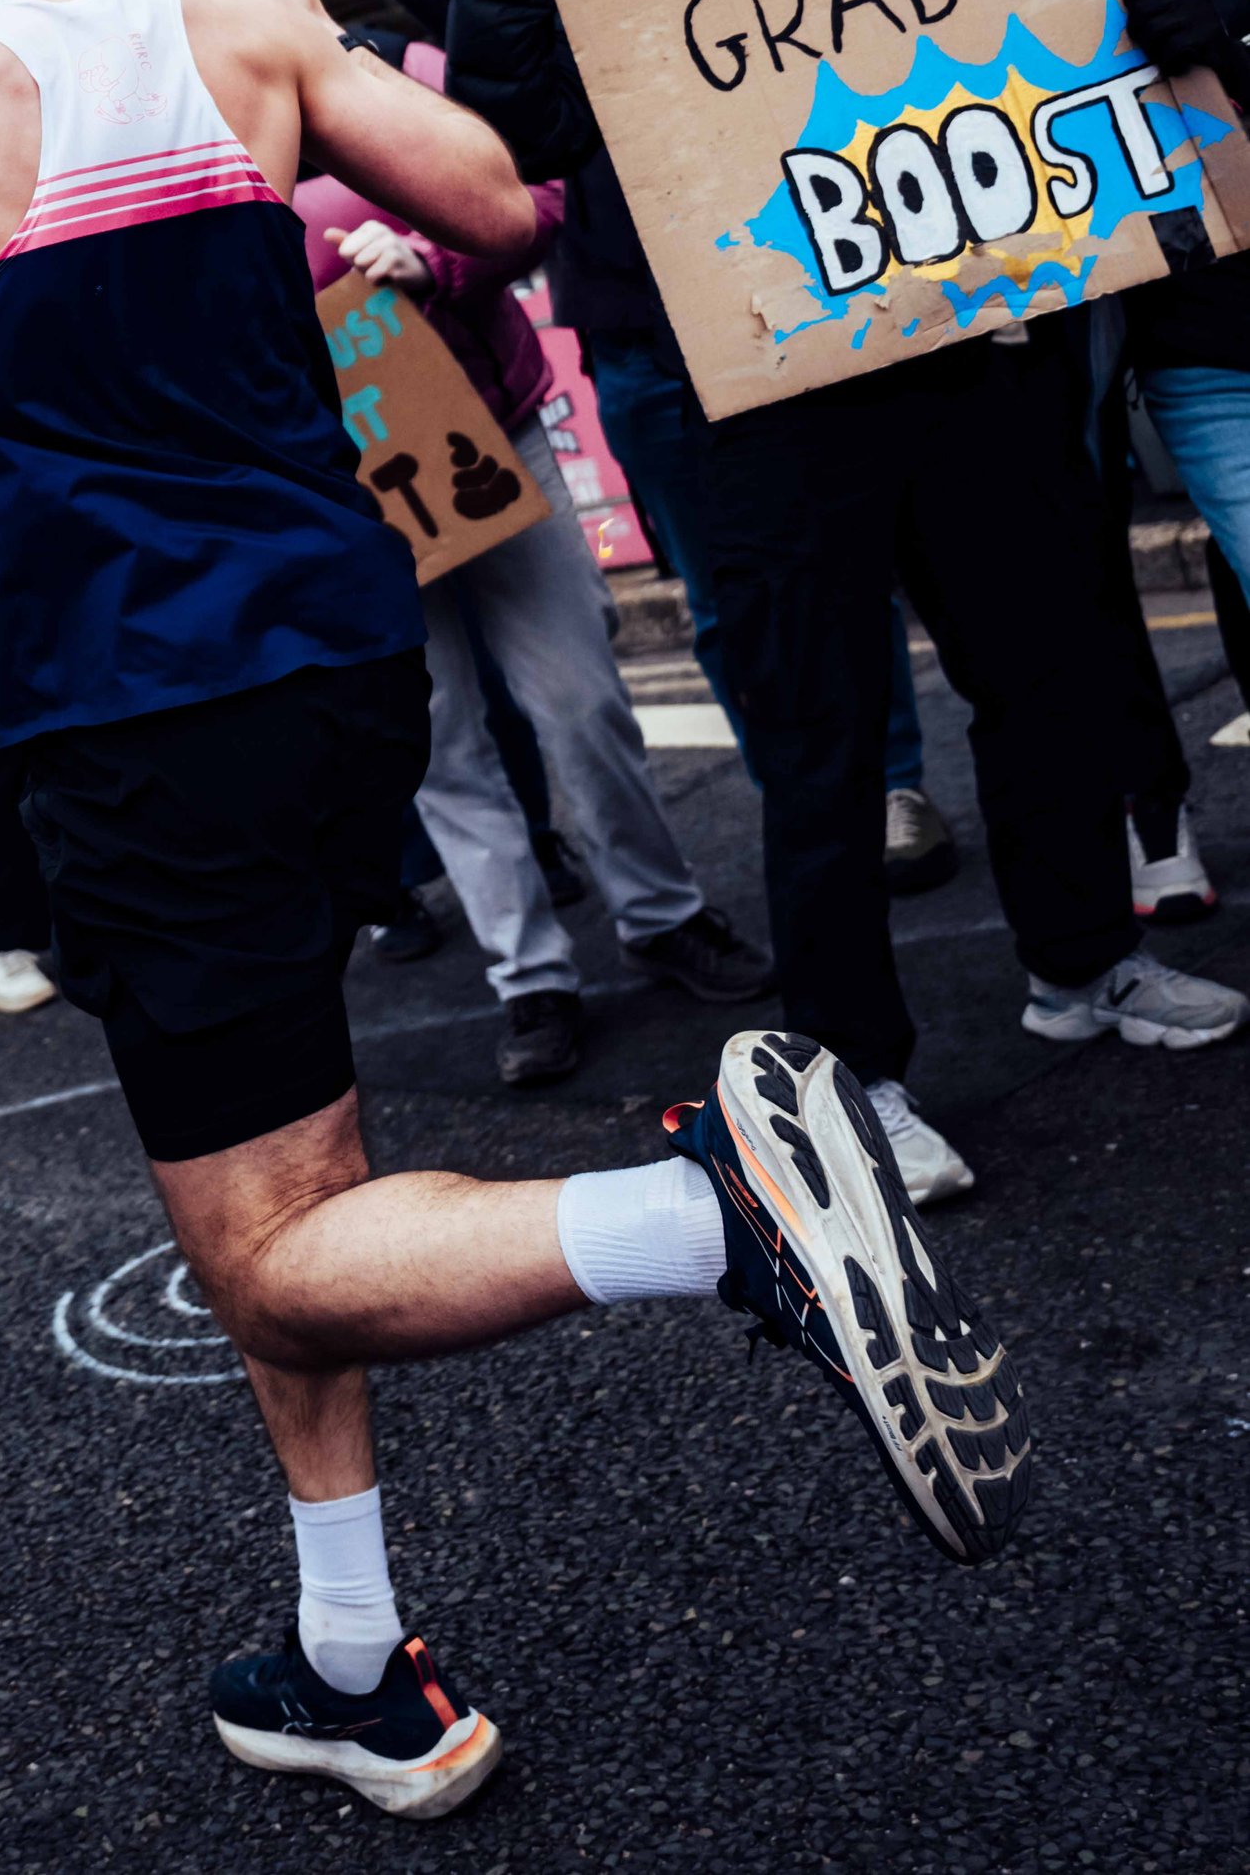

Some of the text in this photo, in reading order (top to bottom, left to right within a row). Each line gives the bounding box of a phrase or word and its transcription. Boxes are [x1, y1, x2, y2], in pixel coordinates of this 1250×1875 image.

[129, 32, 152, 71] RHRC
[781, 65, 1174, 297] BOOST
[324, 287, 403, 371] UST
